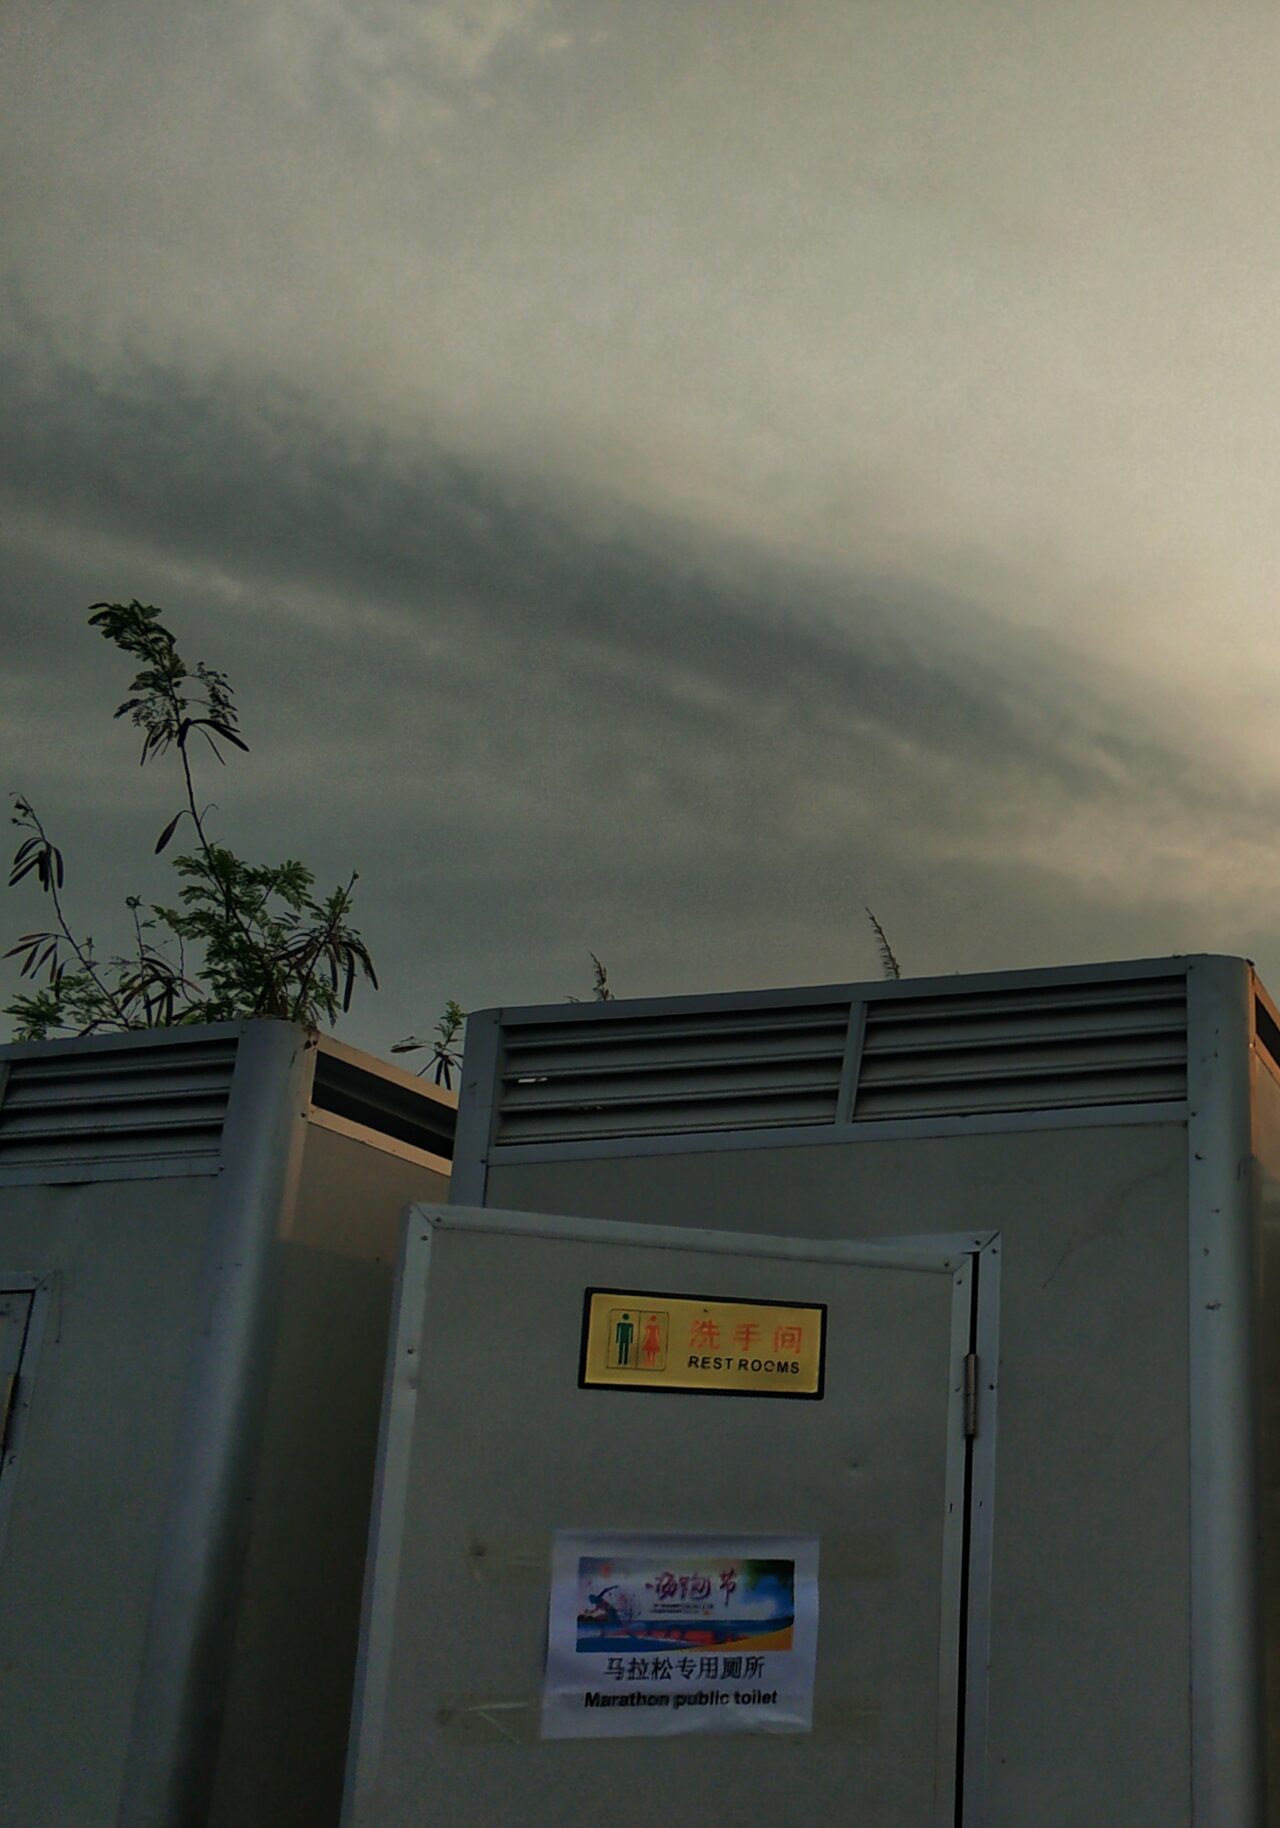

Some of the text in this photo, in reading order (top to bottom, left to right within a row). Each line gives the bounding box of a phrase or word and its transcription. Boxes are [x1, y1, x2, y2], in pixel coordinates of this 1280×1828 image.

[687, 1319, 804, 1354] 洗手间
[687, 1355, 800, 1375] REST ROOMS
[604, 1655, 766, 1681] 马拉松专用厕所
[584, 1689, 778, 1710] Marathon public toilet
